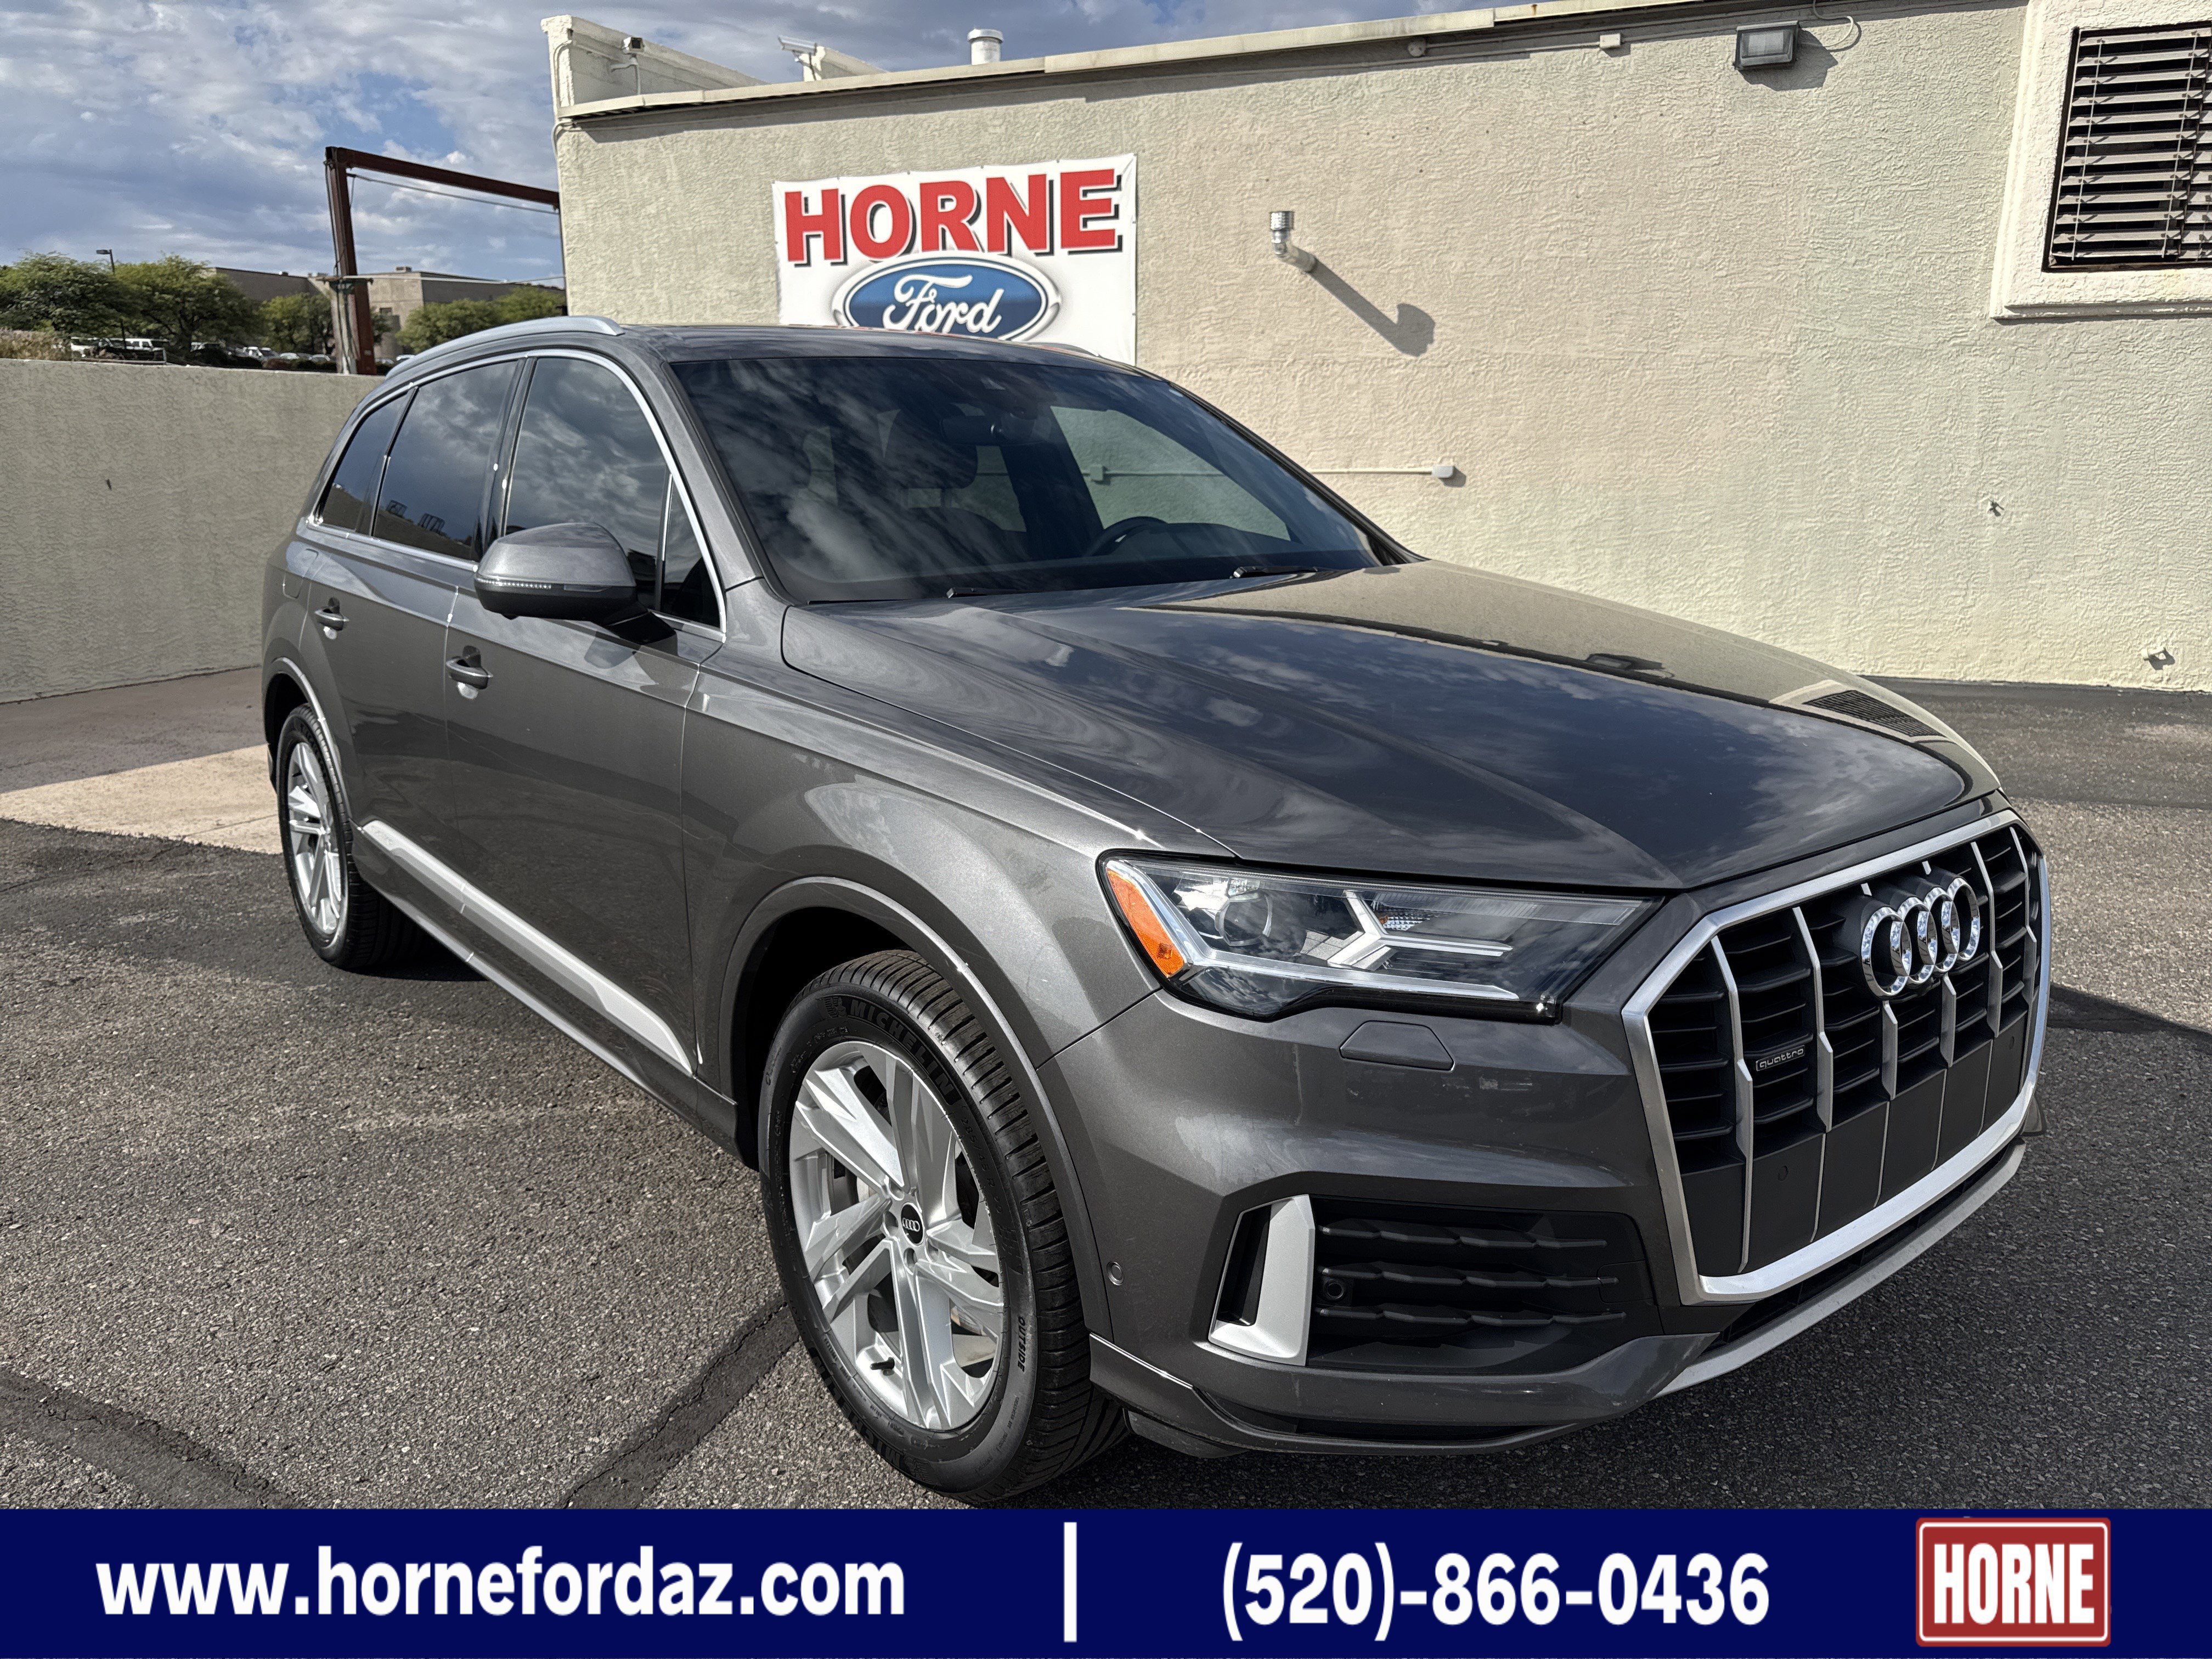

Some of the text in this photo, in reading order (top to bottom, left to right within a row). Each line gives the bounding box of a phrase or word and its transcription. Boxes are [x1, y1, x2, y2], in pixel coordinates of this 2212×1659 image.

[785, 169, 1121, 265] HORNE
[883, 274, 1005, 333] Ford
[850, 999, 954, 1095] MICHELIN
[1759, 1048, 1804, 1069] quattro
[1017, 1316, 1027, 1373] OUTSIDE
